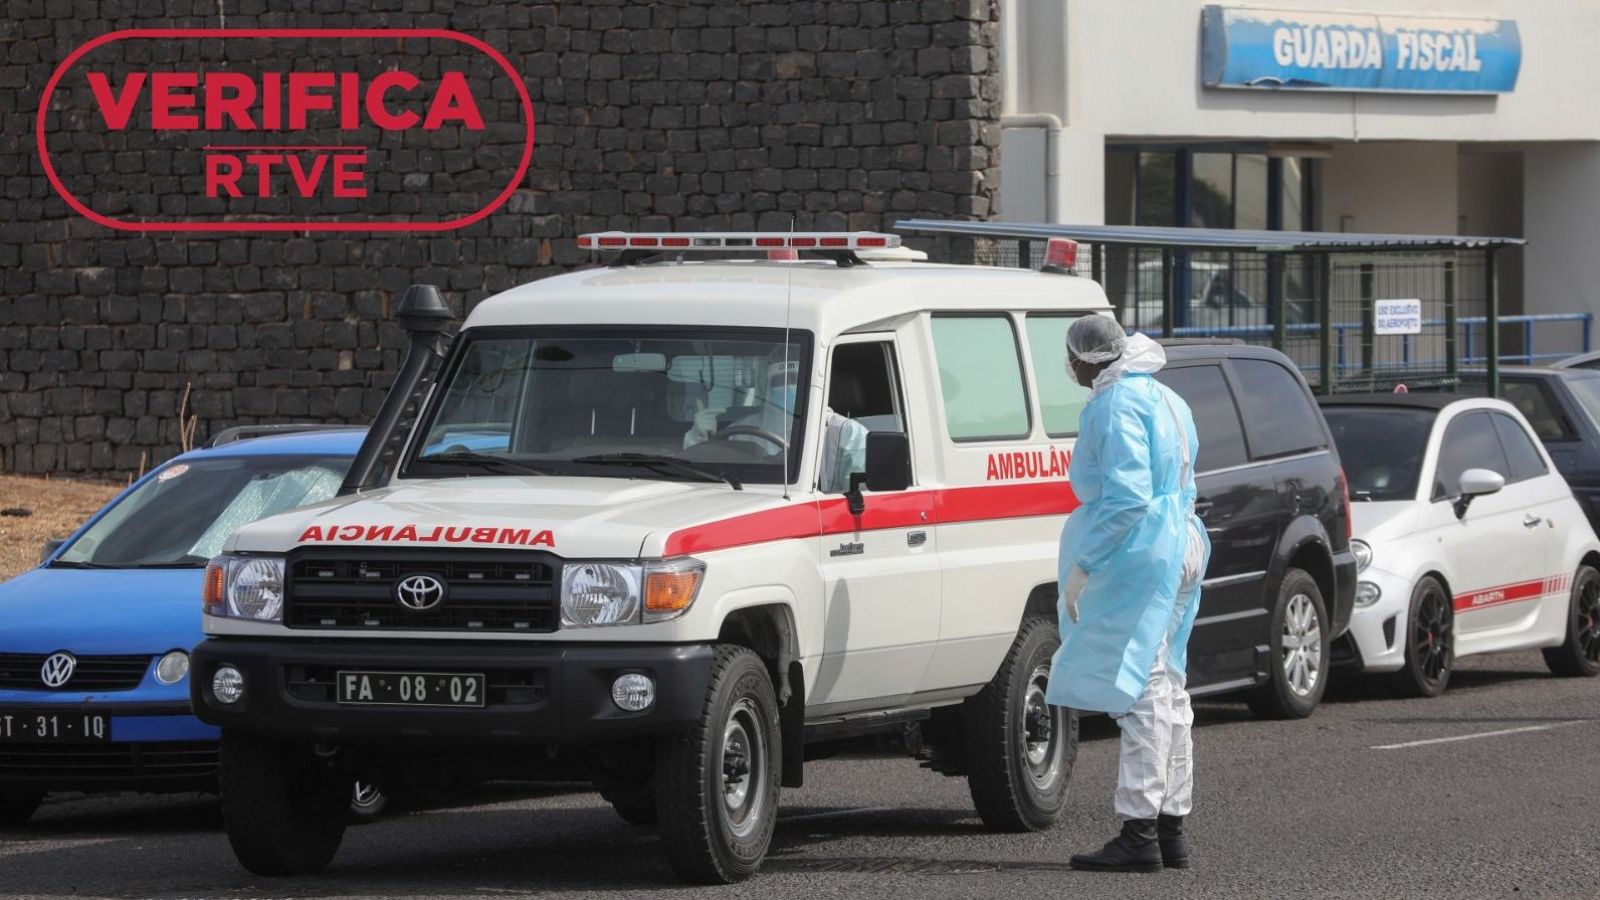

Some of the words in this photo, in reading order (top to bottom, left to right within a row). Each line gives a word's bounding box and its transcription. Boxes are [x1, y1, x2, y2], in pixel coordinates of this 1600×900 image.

[1273, 27, 1382, 69] GUARDA
[1396, 32, 1482, 72] FISCAL
[1472, 590, 1505, 606] ABARTH
[345, 675, 374, 700] FA
[400, 675, 427, 701] 08
[450, 676, 477, 702] 02
[0, 715, 14, 737] T
[37, 715, 58, 737] 31
